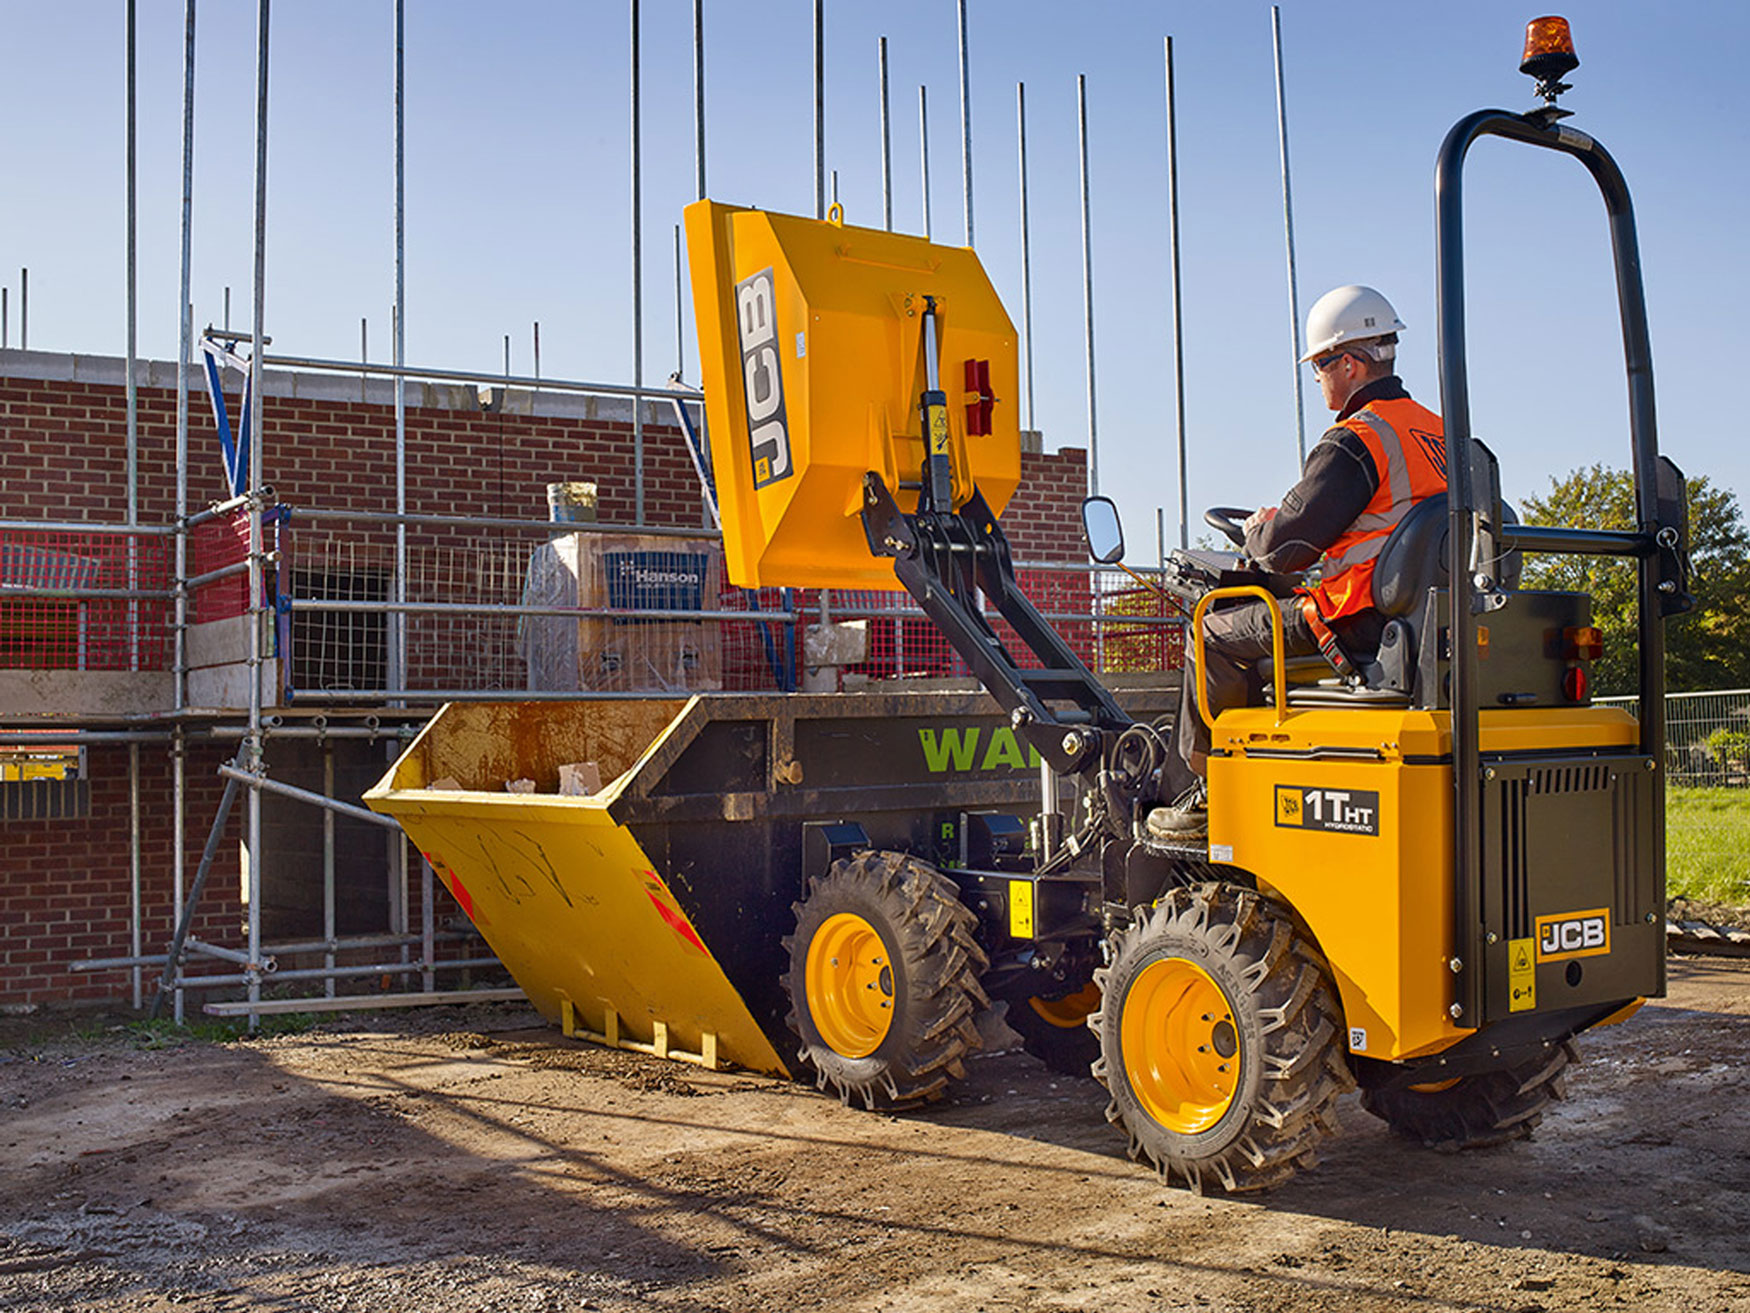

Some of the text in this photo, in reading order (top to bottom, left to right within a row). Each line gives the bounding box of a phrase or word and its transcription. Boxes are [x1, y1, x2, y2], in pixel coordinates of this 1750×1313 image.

[738, 275, 788, 477] JCB
[635, 569, 699, 584] Hanson
[1542, 918, 1604, 953] JCB
